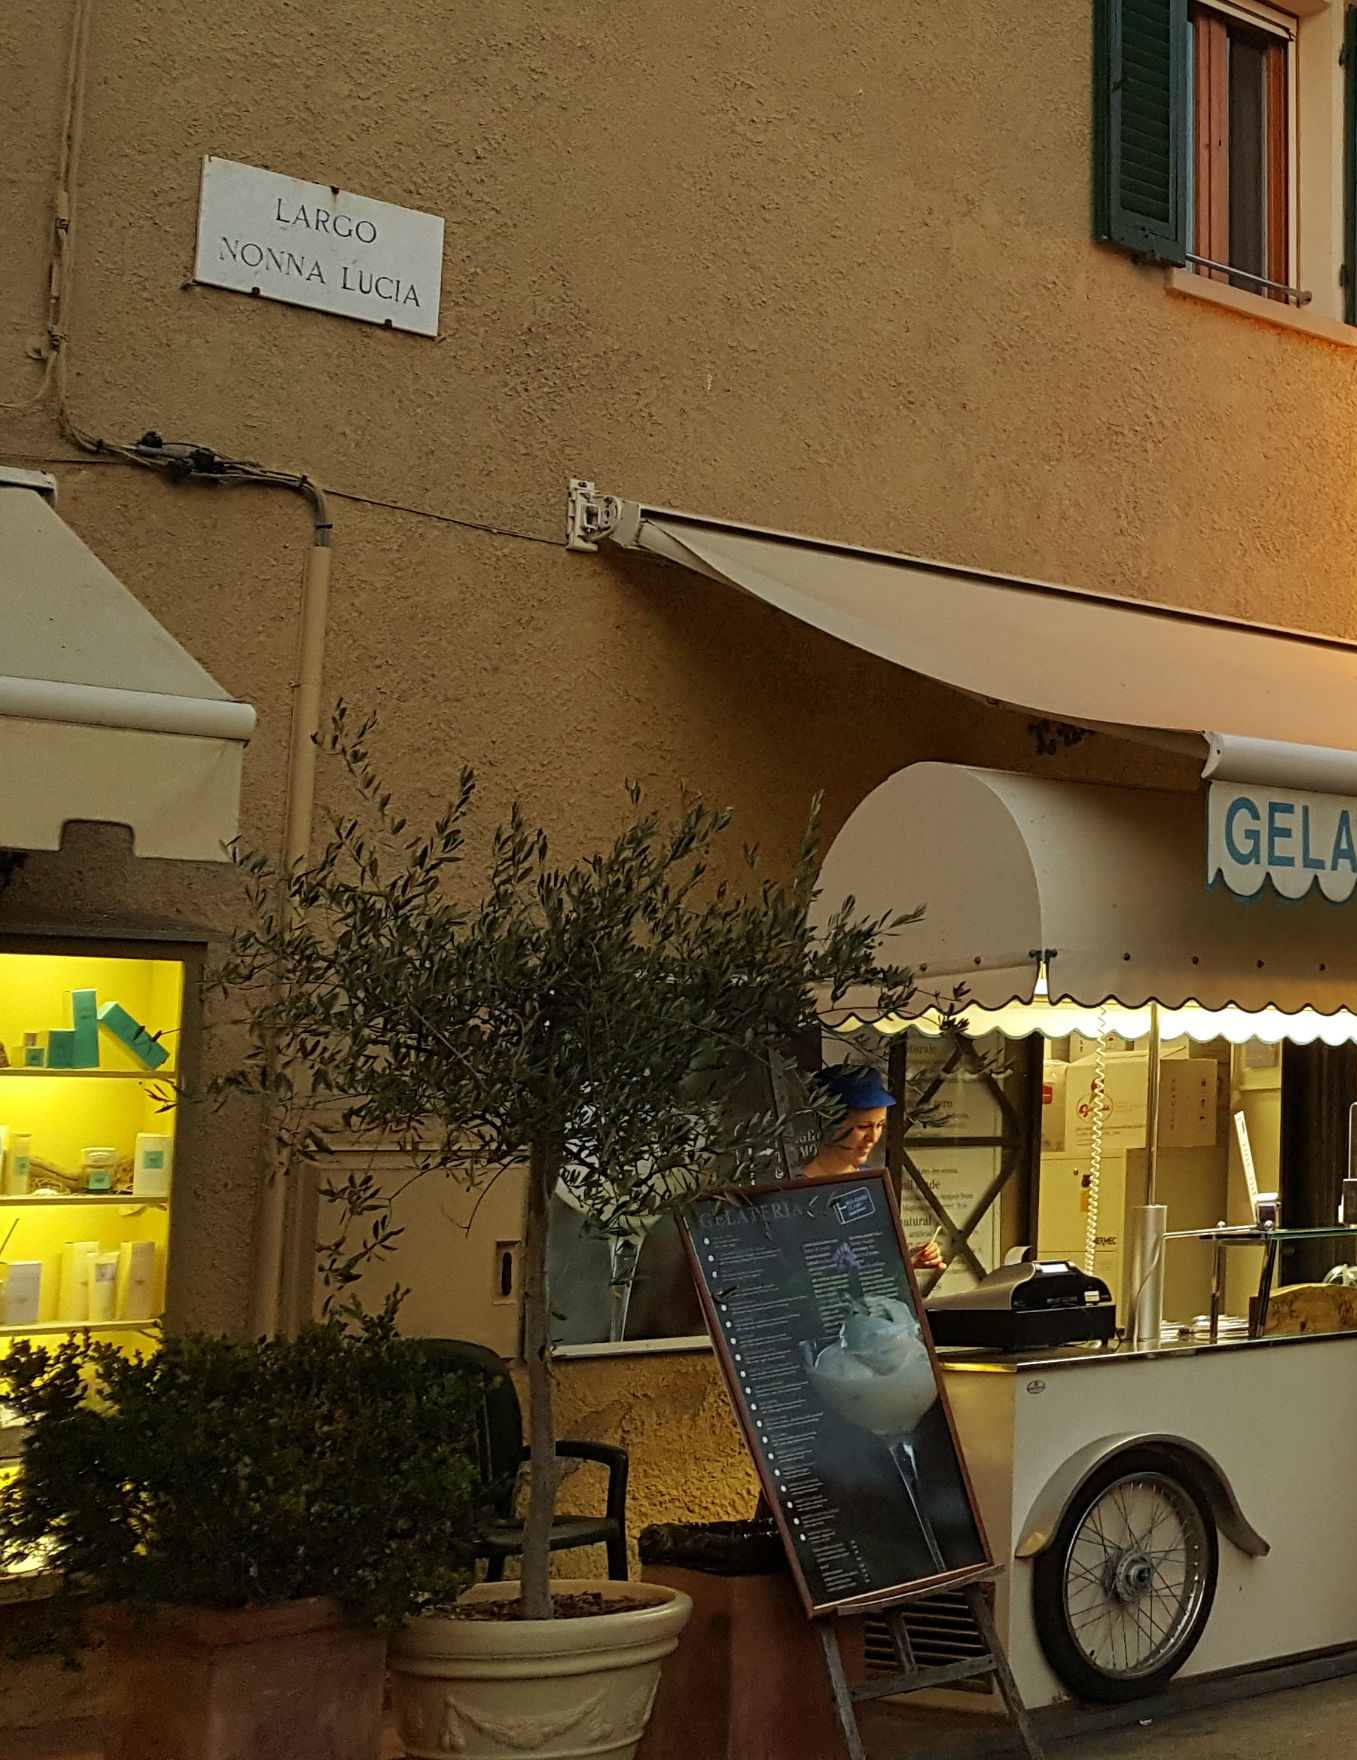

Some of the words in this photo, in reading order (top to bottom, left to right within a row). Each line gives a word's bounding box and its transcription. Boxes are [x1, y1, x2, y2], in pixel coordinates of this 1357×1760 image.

[275, 198, 377, 243] LARGO
[219, 236, 327, 284] NONNA
[340, 266, 421, 307] LUCIA
